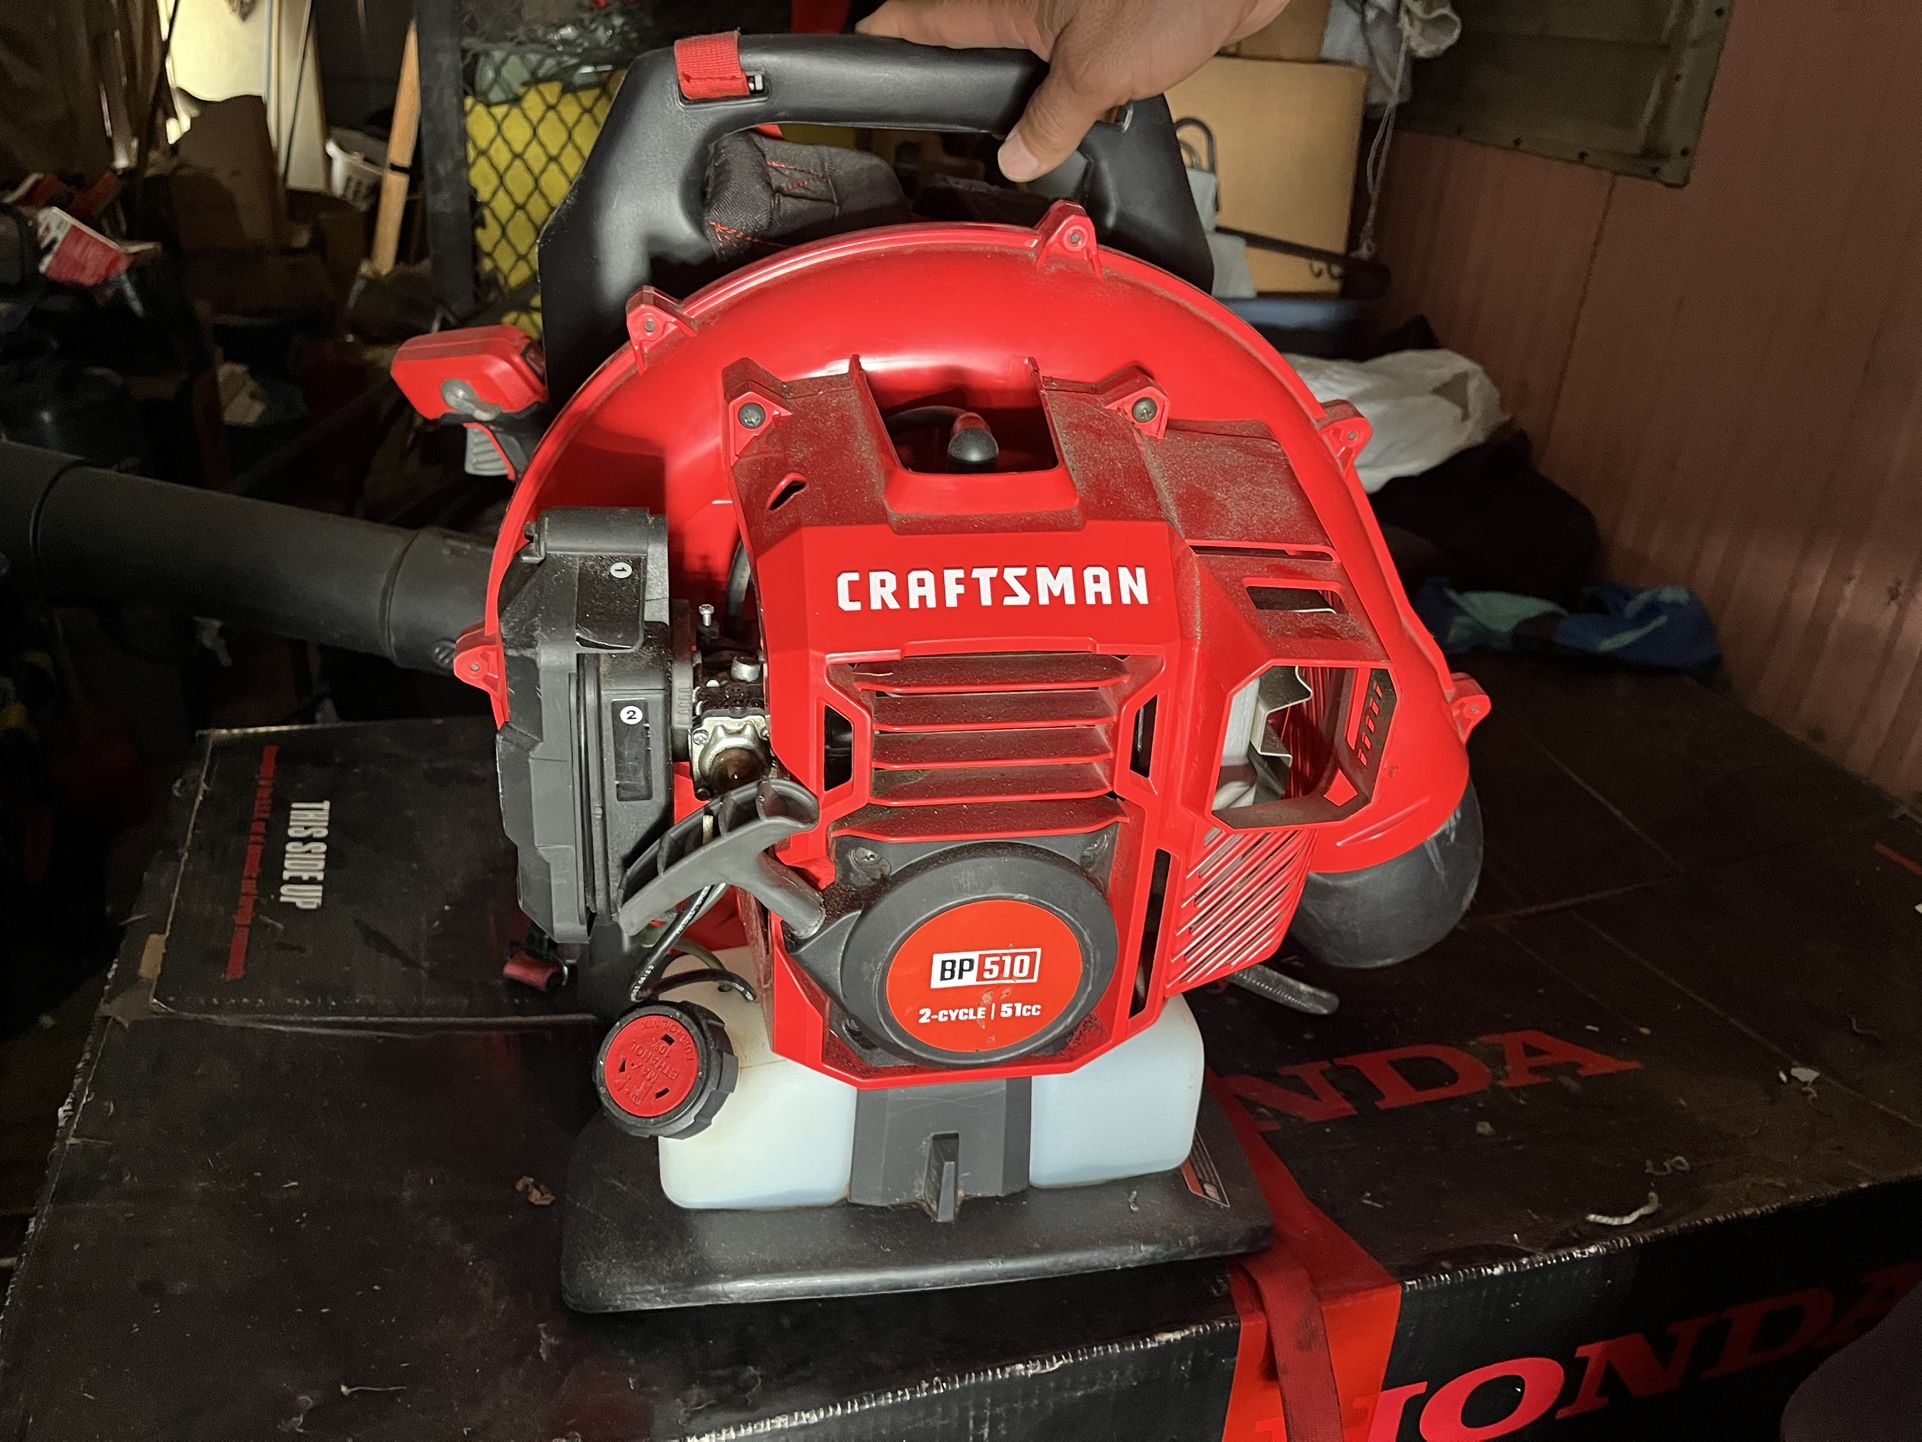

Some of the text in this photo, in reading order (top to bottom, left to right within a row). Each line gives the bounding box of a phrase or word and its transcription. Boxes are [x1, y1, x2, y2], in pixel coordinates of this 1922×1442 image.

[837, 566, 1149, 611] CRAFTSMAN
[279, 800, 331, 909] THIS SIDE UP
[940, 955, 1031, 981] BP 510
[918, 1007, 987, 1024] 2-CYCLE
[630, 1040, 679, 1081] ETHANOL
[1208, 1028, 1645, 1134] NDA
